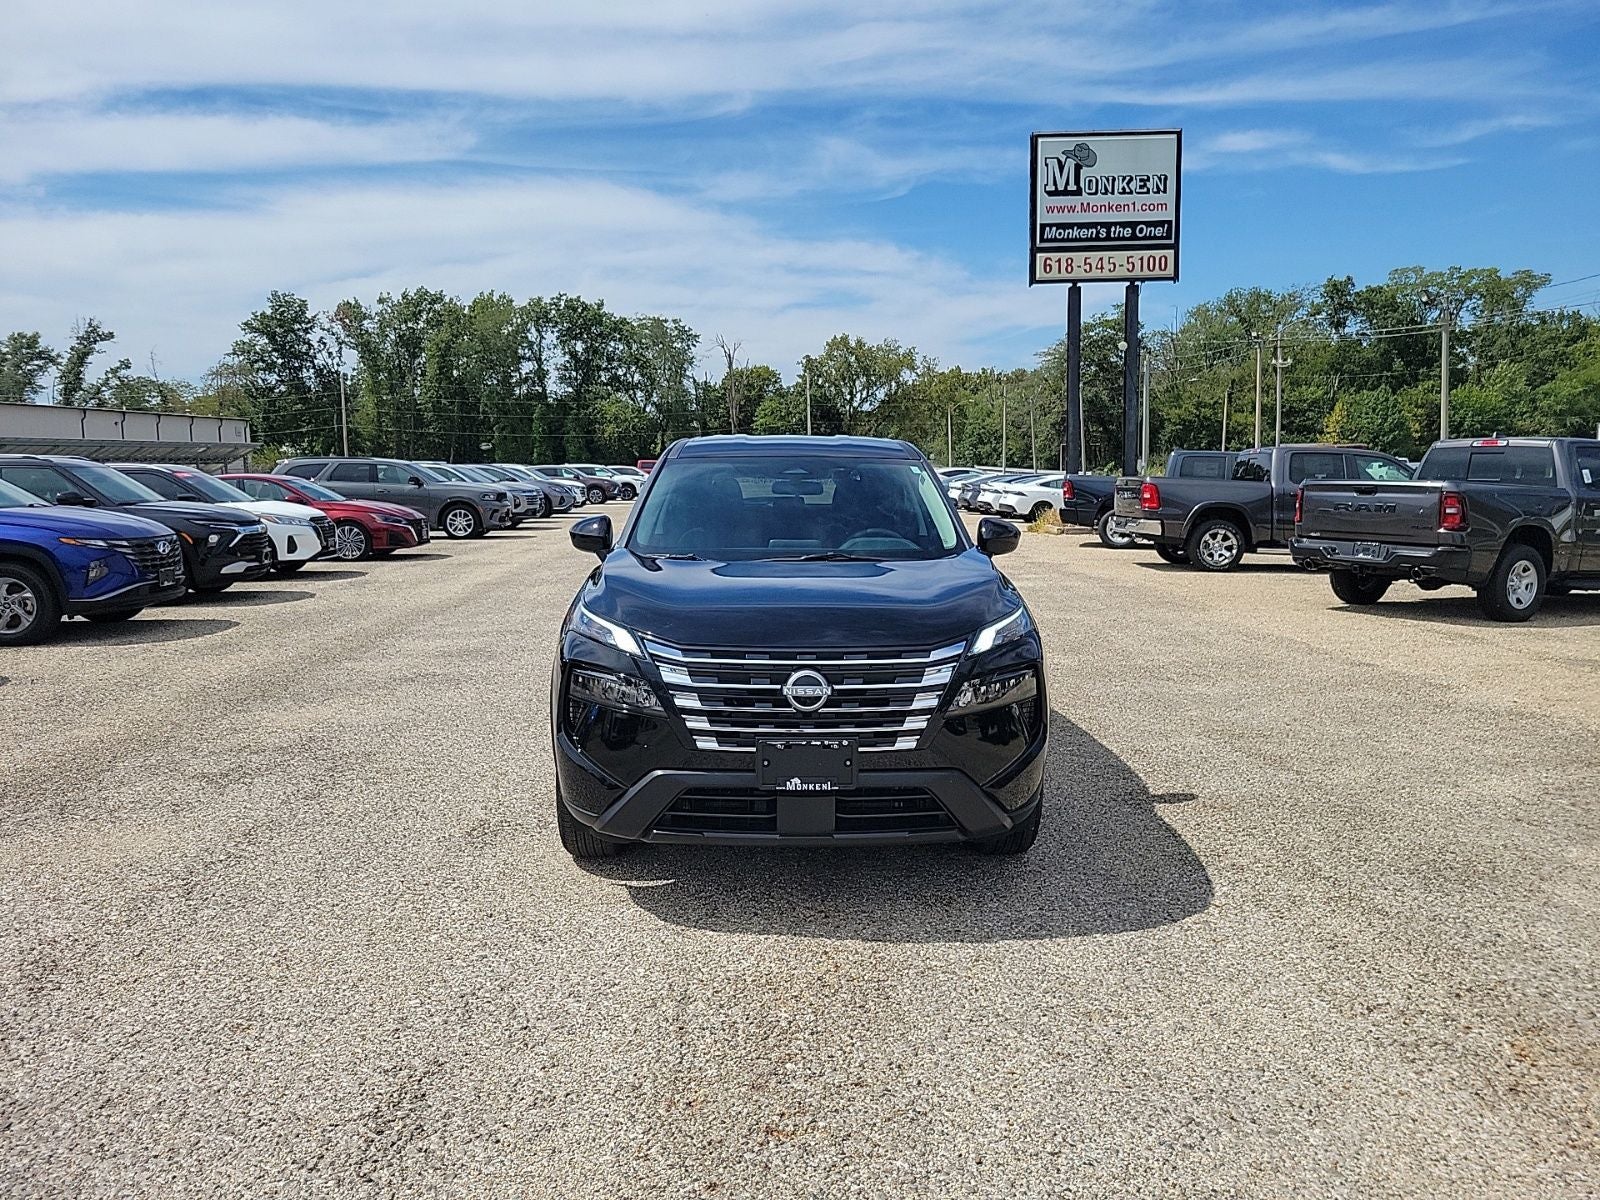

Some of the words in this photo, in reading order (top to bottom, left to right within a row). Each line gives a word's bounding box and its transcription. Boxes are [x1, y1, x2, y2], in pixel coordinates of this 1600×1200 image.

[1044, 157, 1168, 197] MONKEN
[1045, 201, 1168, 214] www.Monken1.com
[1043, 225, 1107, 239] Monken's
[1110, 225, 1132, 238] the
[1136, 223, 1168, 237] One!
[1043, 254, 1169, 275] 618-545-5100
[1333, 502, 1397, 513] RAM
[783, 687, 831, 695] NISSAN
